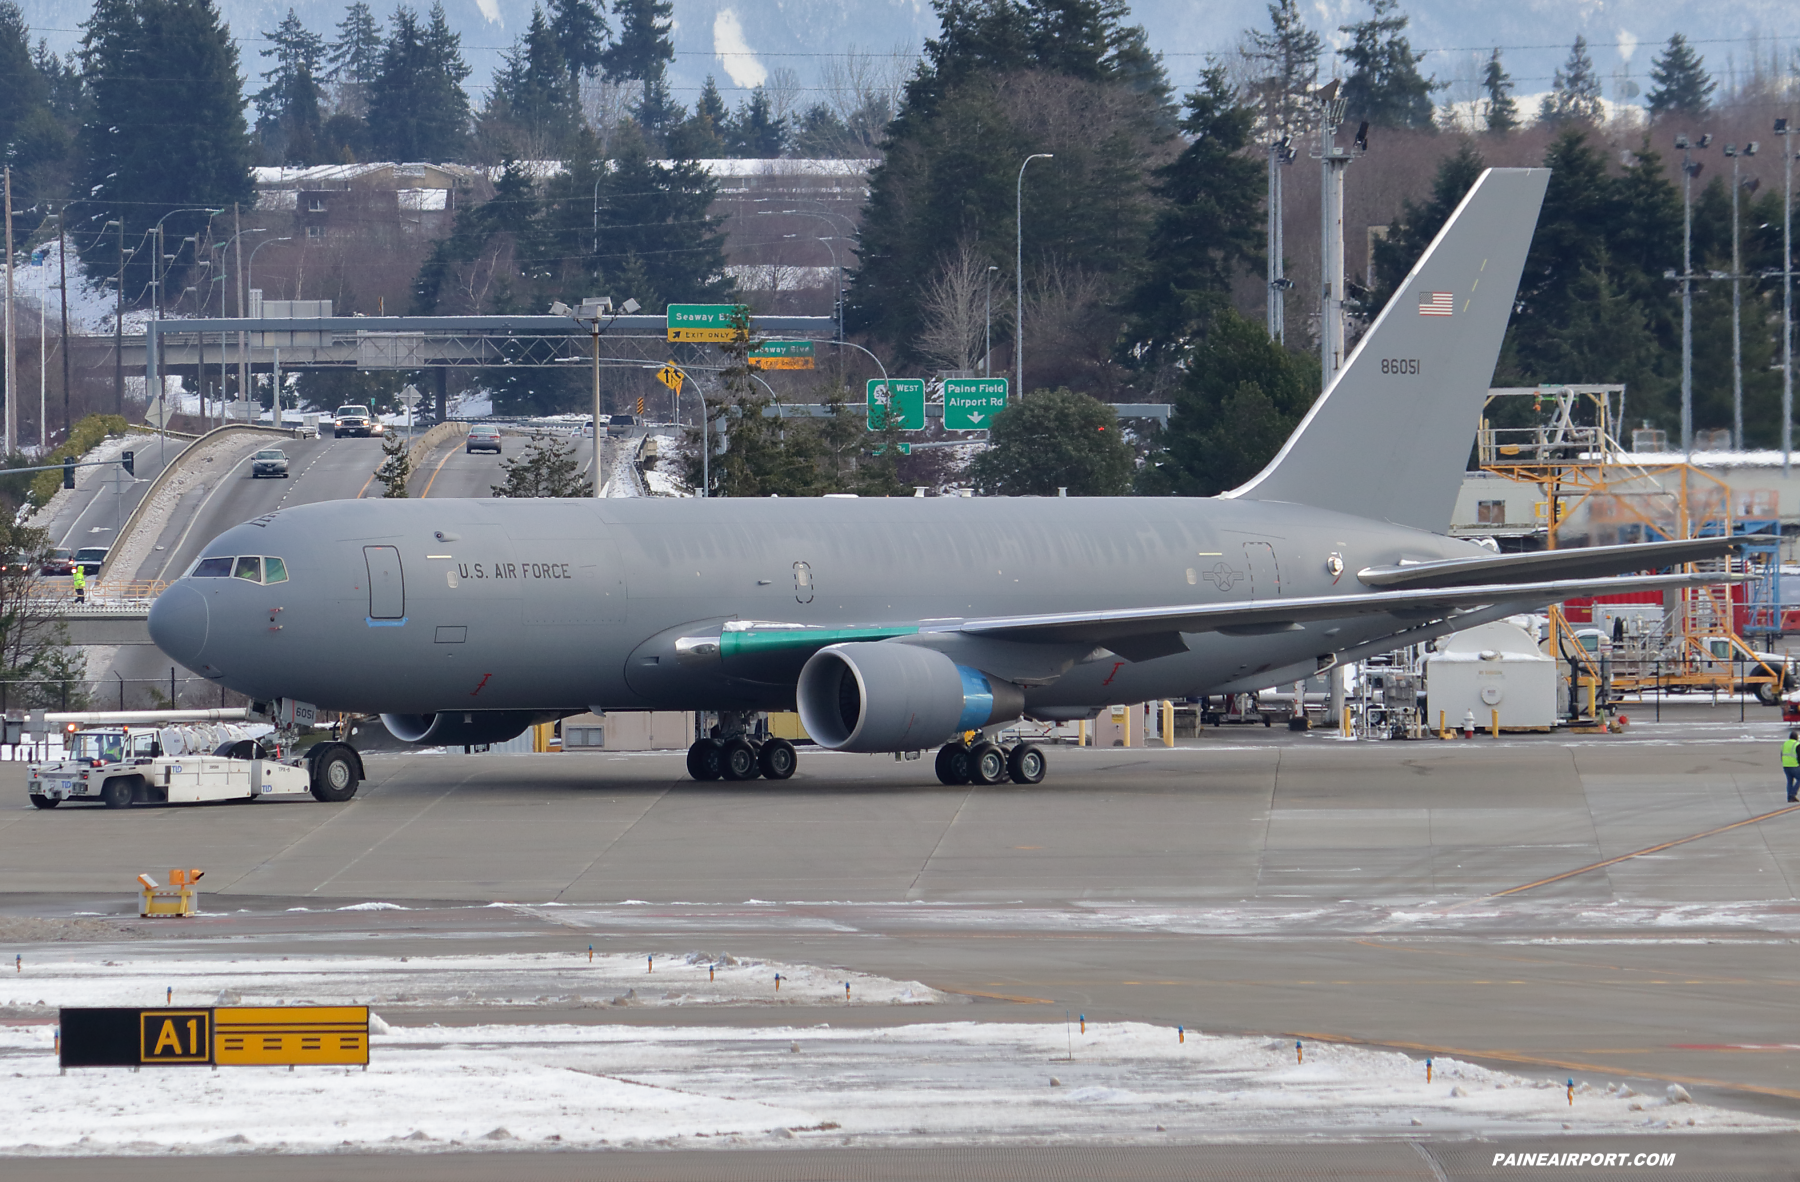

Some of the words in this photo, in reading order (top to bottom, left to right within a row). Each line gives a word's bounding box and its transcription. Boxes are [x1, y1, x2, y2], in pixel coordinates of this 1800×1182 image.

[676, 313, 714, 322] Seaway
[1381, 359, 1420, 374] 86051
[947, 384, 977, 393] Paine
[980, 384, 1004, 393] Field
[949, 398, 986, 408] Airport
[990, 398, 1003, 406] Rd
[458, 563, 489, 579] U.S.
[495, 563, 517, 579] AIR
[521, 563, 571, 579] FORCE
[296, 707, 315, 720] 6051
[171, 765, 182, 773] TLD
[61, 781, 72, 789] TLD
[262, 785, 272, 793] TLD
[153, 1019, 197, 1054] A1
